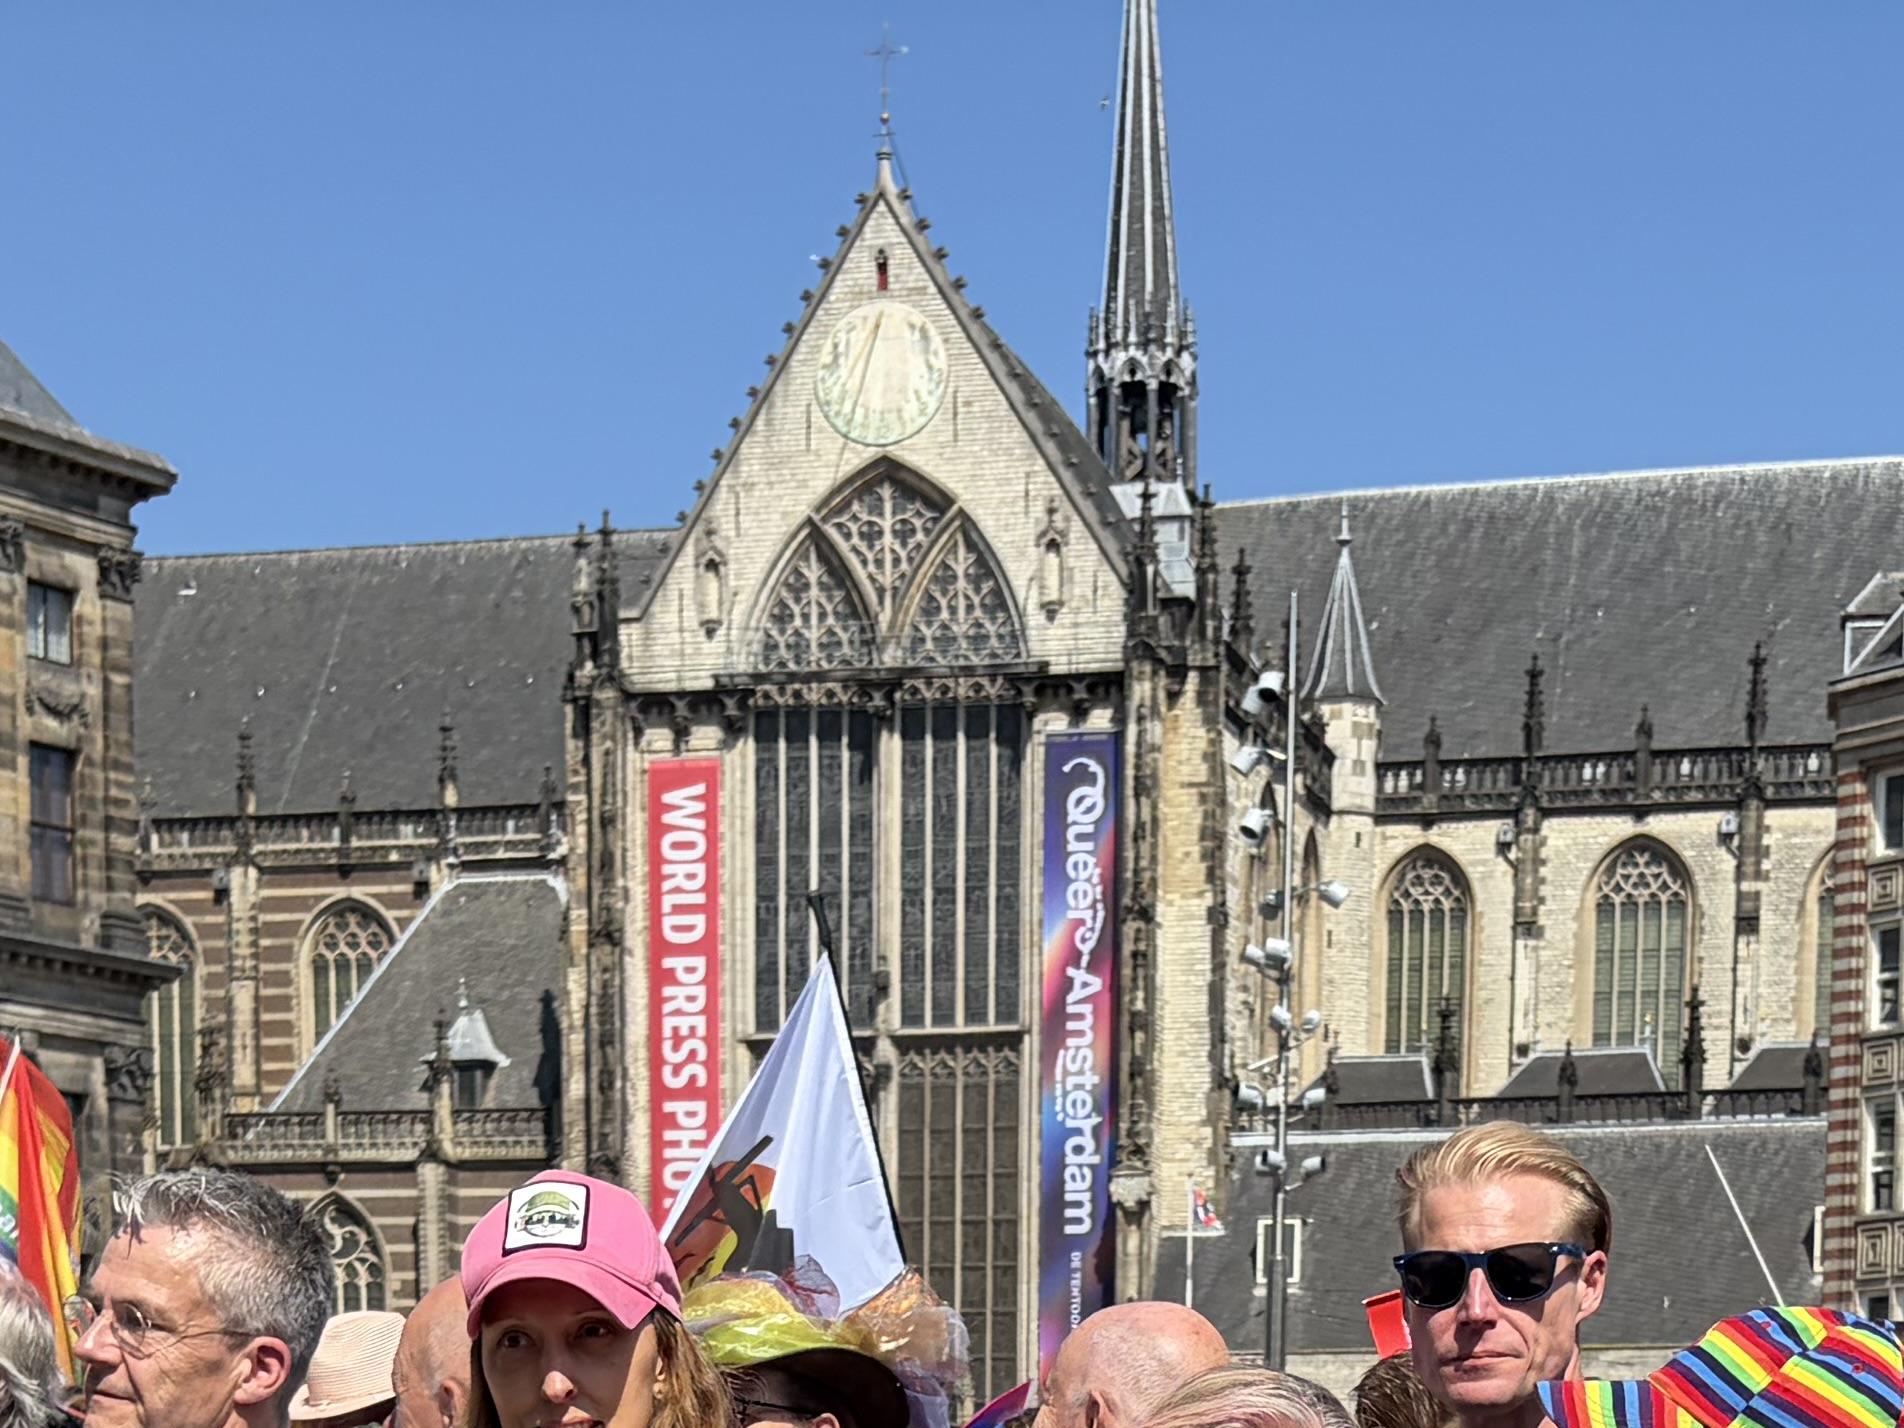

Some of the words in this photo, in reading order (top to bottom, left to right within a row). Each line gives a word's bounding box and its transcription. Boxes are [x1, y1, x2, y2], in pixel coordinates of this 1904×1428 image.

[661, 783, 707, 944] WORLD
[661, 956, 707, 1089] PRESS
[661, 1101, 707, 1210] PHO
[1063, 966, 1103, 1236] Amsterdam
